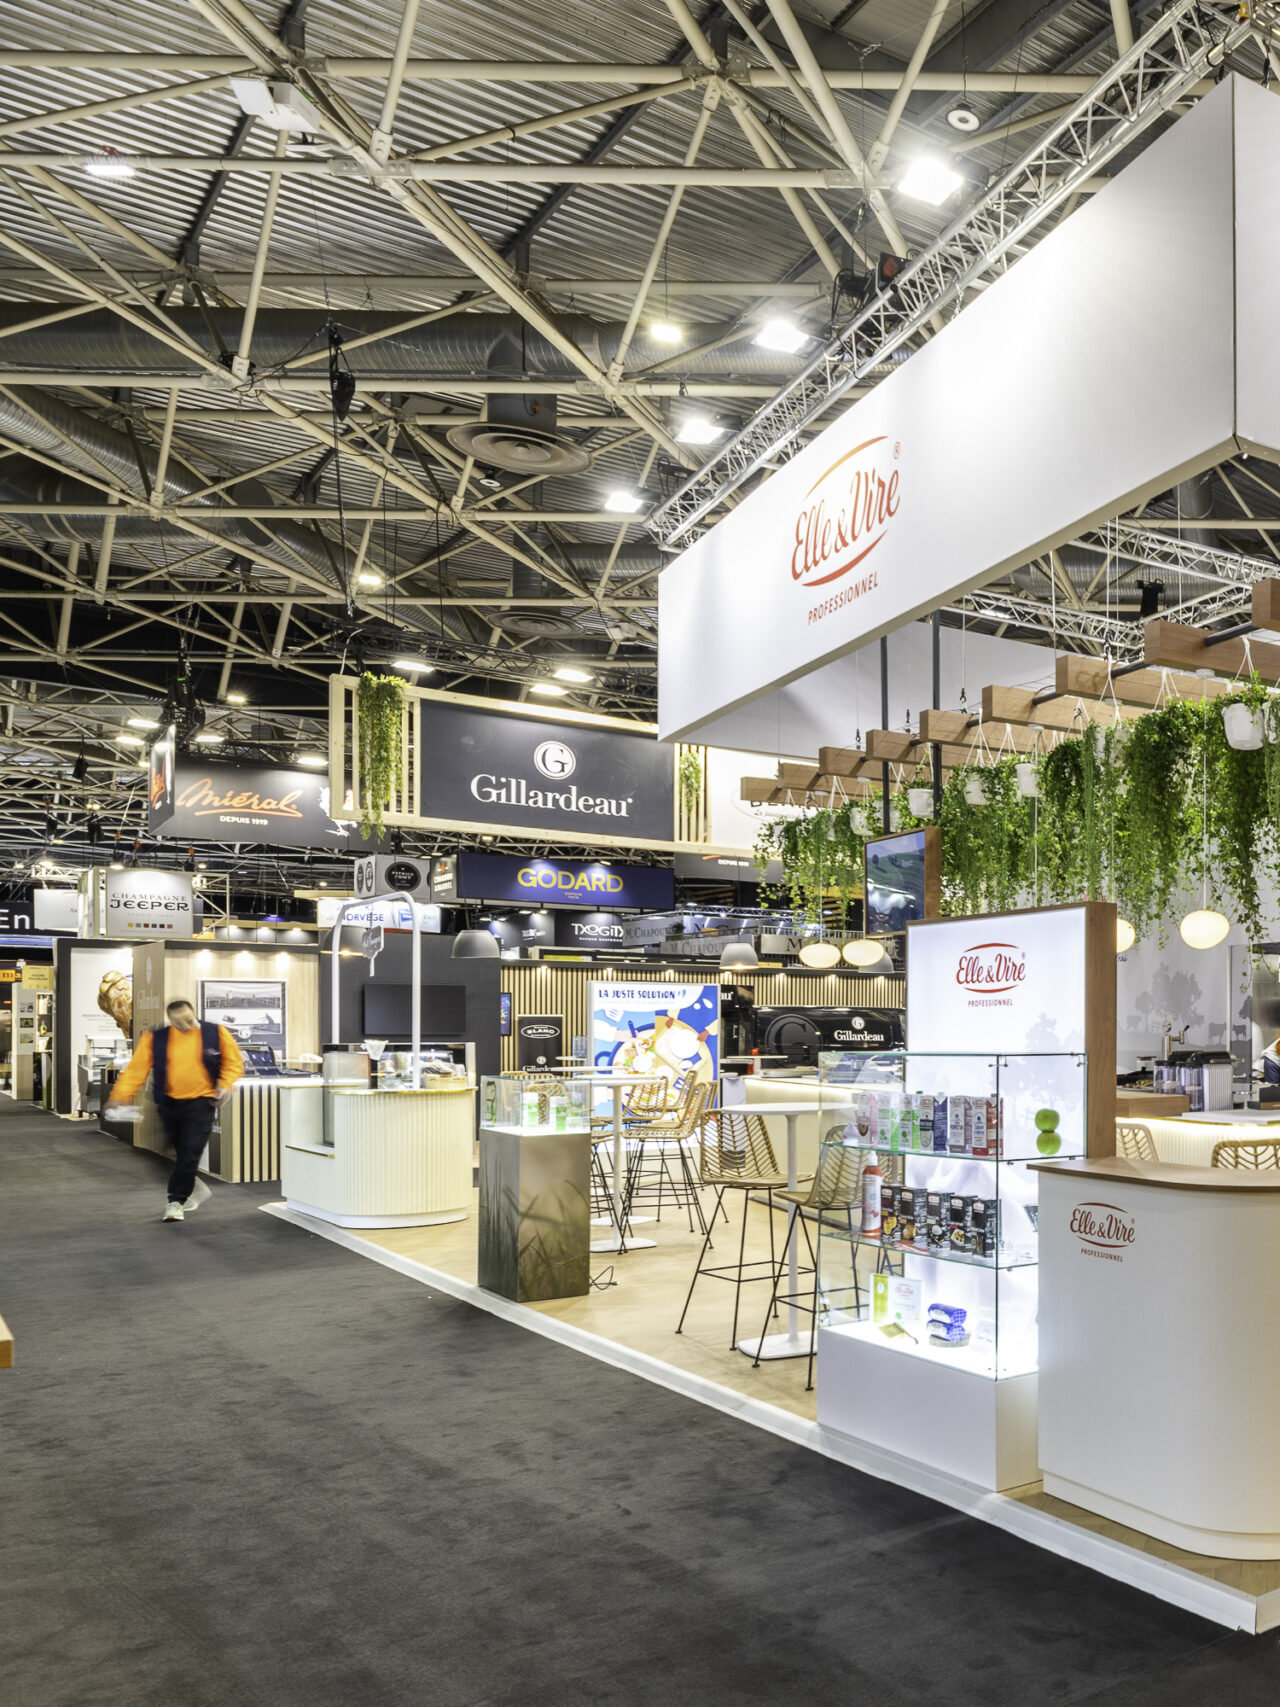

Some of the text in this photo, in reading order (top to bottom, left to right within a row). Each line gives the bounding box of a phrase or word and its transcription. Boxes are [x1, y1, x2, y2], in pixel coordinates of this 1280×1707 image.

[807, 571, 879, 626] PROFESSIONNEL
[470, 773, 630, 818] Gillardeau
[219, 815, 268, 825] DEPUIS 1919
[517, 868, 624, 892] GODARD
[112, 892, 187, 902] CHAMPAGNE
[109, 899, 190, 911] JEEPER
[599, 990, 609, 998] LA
[612, 990, 635, 998] JUSTE
[968, 998, 1013, 1007] PROFESSIONNEL
[834, 1029, 884, 1042] Gillardeau
[1081, 1247, 1123, 1262] PROFESSIONNEL
